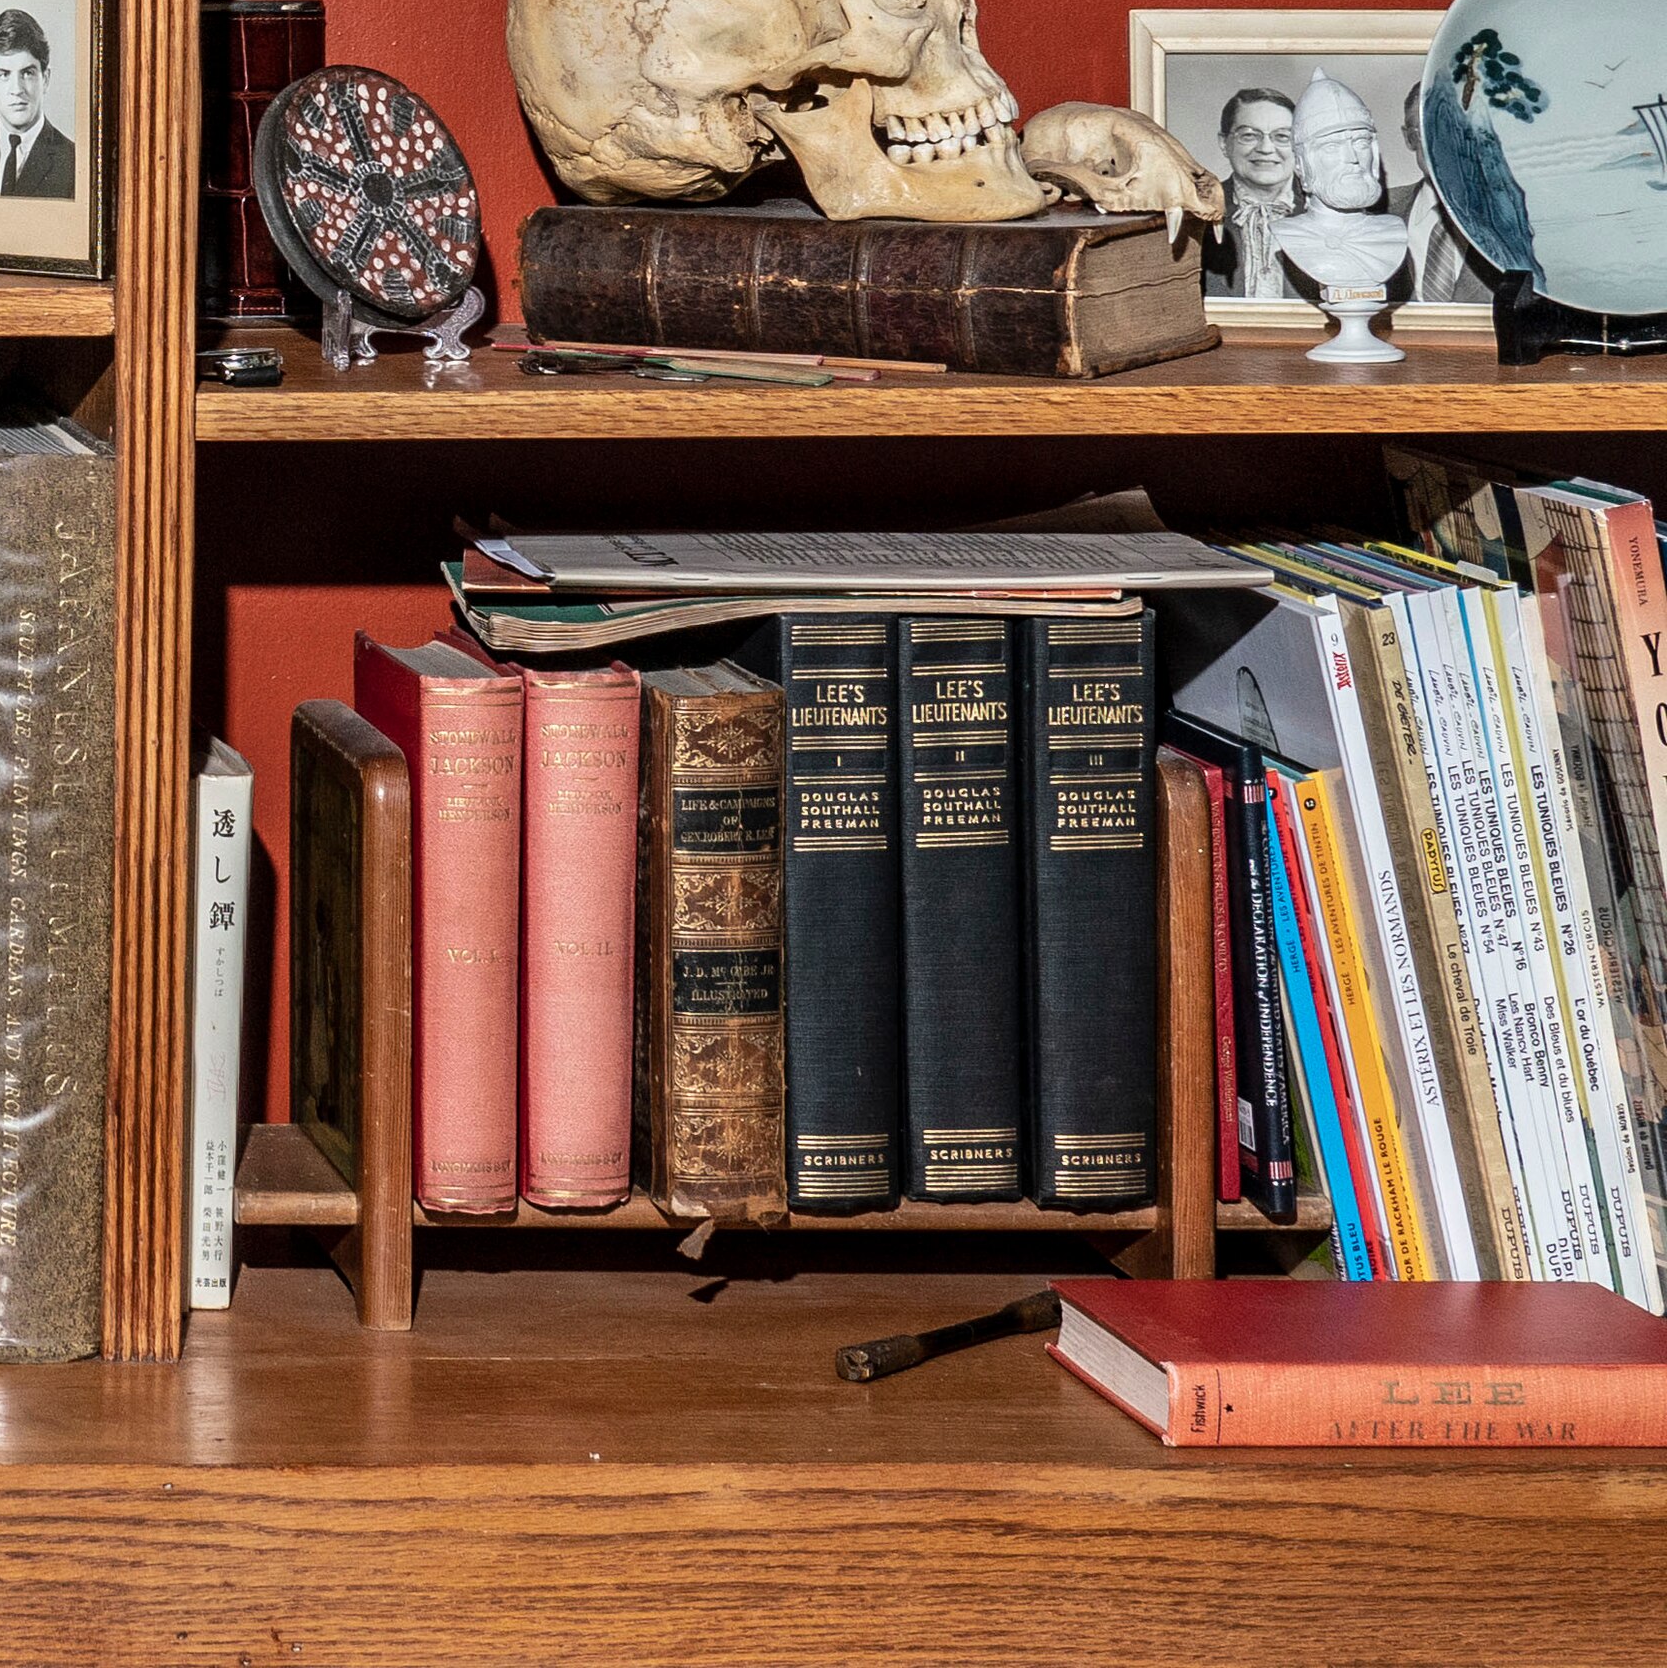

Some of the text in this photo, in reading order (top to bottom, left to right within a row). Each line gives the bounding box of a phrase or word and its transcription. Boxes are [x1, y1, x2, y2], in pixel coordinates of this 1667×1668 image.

[1382, 632, 1395, 646] 23
[817, 685, 864, 702] LEE'S
[1074, 683, 1120, 701] LEE'S
[792, 707, 887, 726] LIEUTENANTS
[1049, 705, 1143, 725] LIEUTENANTS
[1058, 790, 1135, 801] DOUGLAS
[1058, 804, 1135, 815] SOUTHALL
[1058, 817, 1134, 828] FREEMAN
[1378, 869, 1411, 969] NORMANDS
[1403, 975, 1417, 1003] LES
[1446, 942, 1476, 1055] Le cheval de Troie
[1406, 1007, 1420, 1030] ET
[1580, 1025, 1590, 1039] du
[1584, 1044, 1599, 1091] Québec
[1061, 1153, 1142, 1166] SCRIBNERS
[1383, 1382, 1525, 1406] LEE
[1191, 1385, 1206, 1432] Fishwick
[1517, 1420, 1577, 1441] WAR
